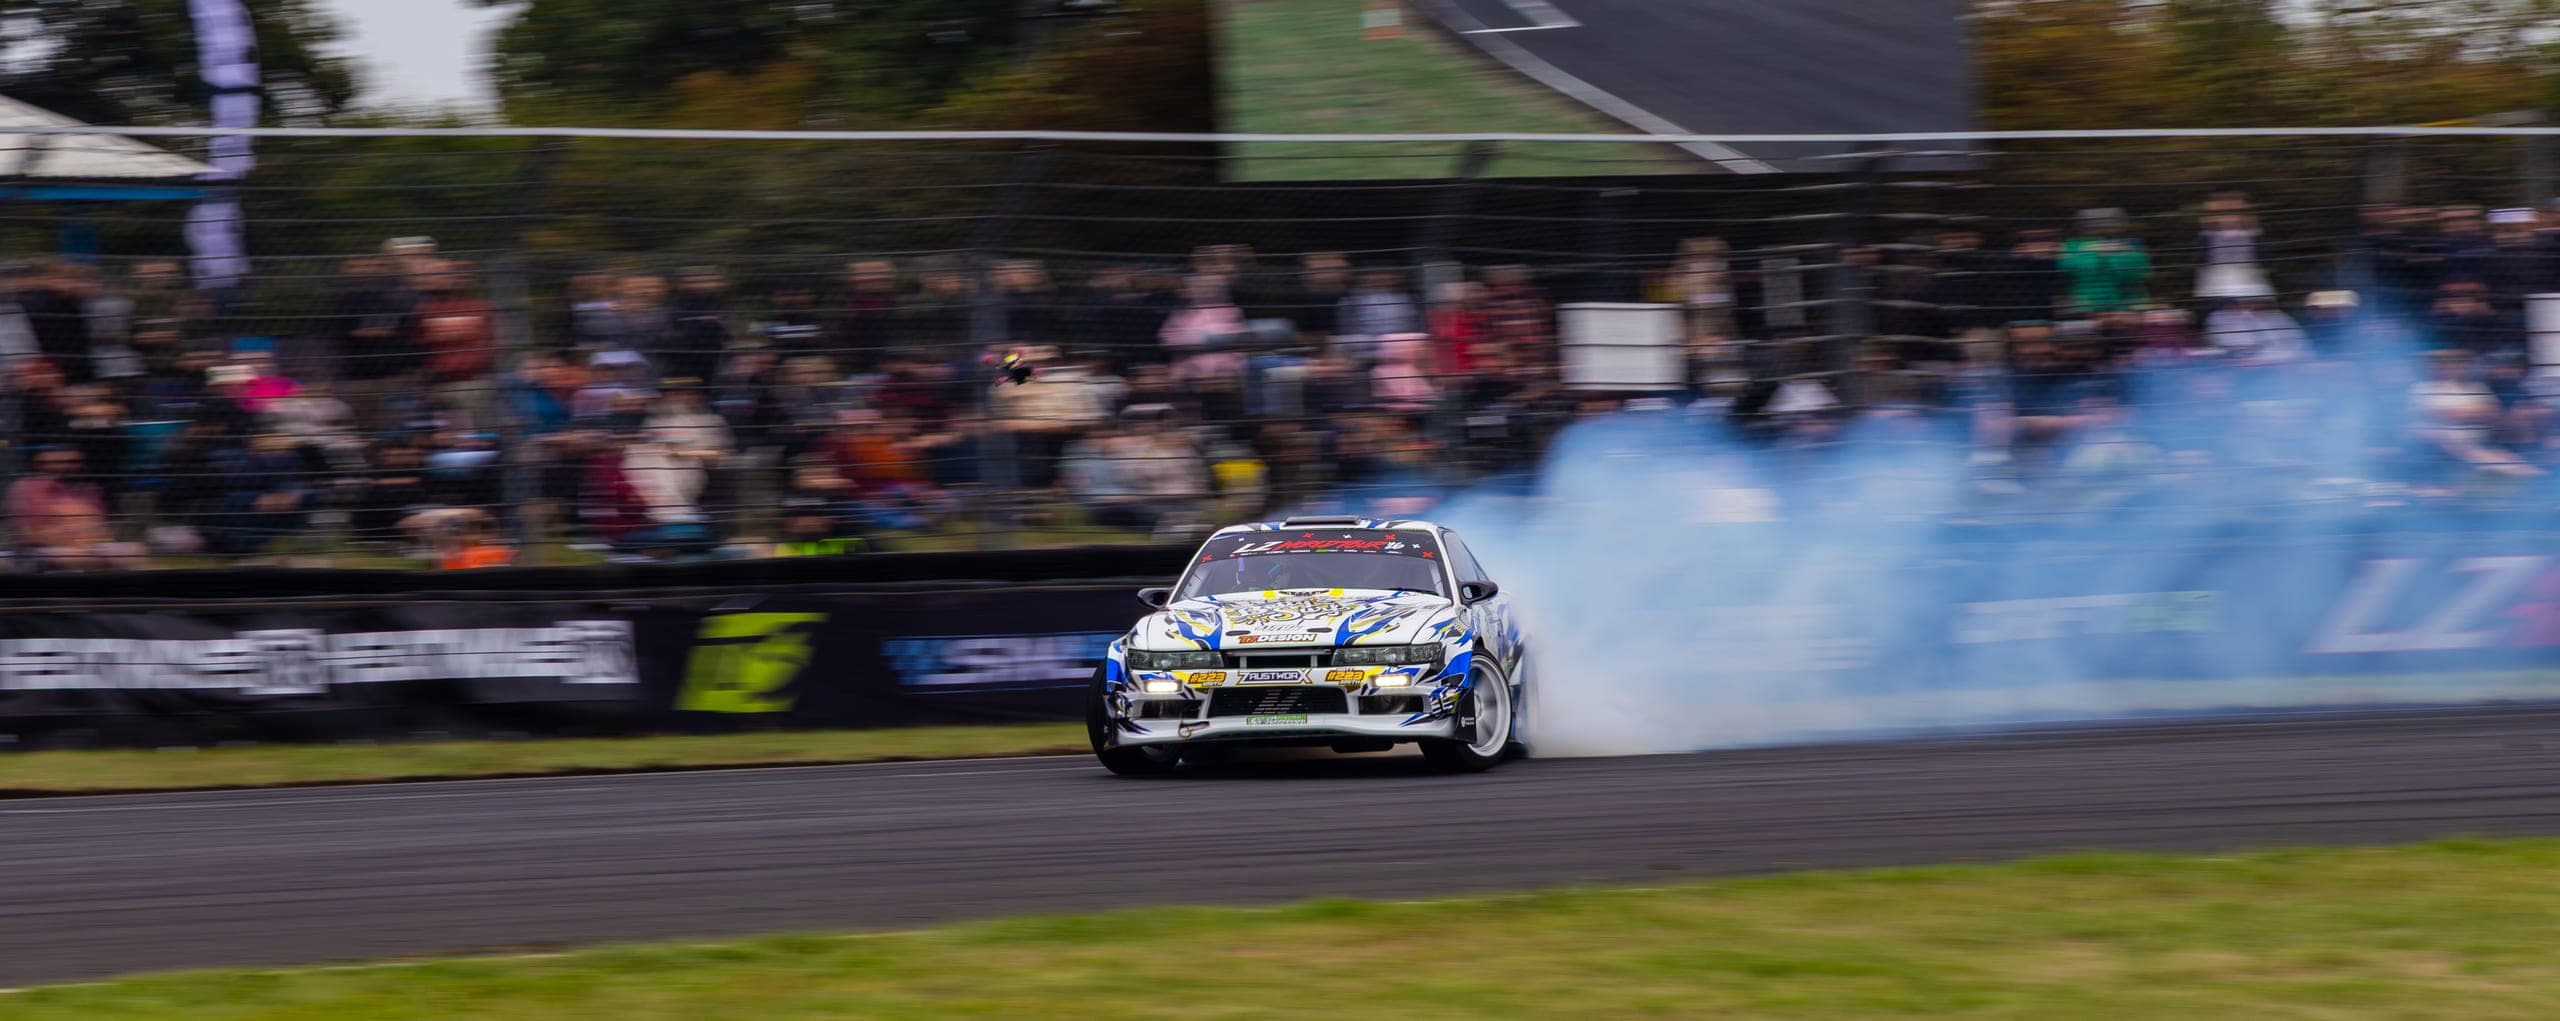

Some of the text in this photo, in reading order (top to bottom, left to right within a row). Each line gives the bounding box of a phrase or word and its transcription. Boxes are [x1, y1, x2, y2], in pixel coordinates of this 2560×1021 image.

[1232, 541, 1284, 553] LZ
[2300, 555, 2548, 653] LZ
[1190, 672, 1226, 683] #223
[1326, 670, 1364, 682] #223
